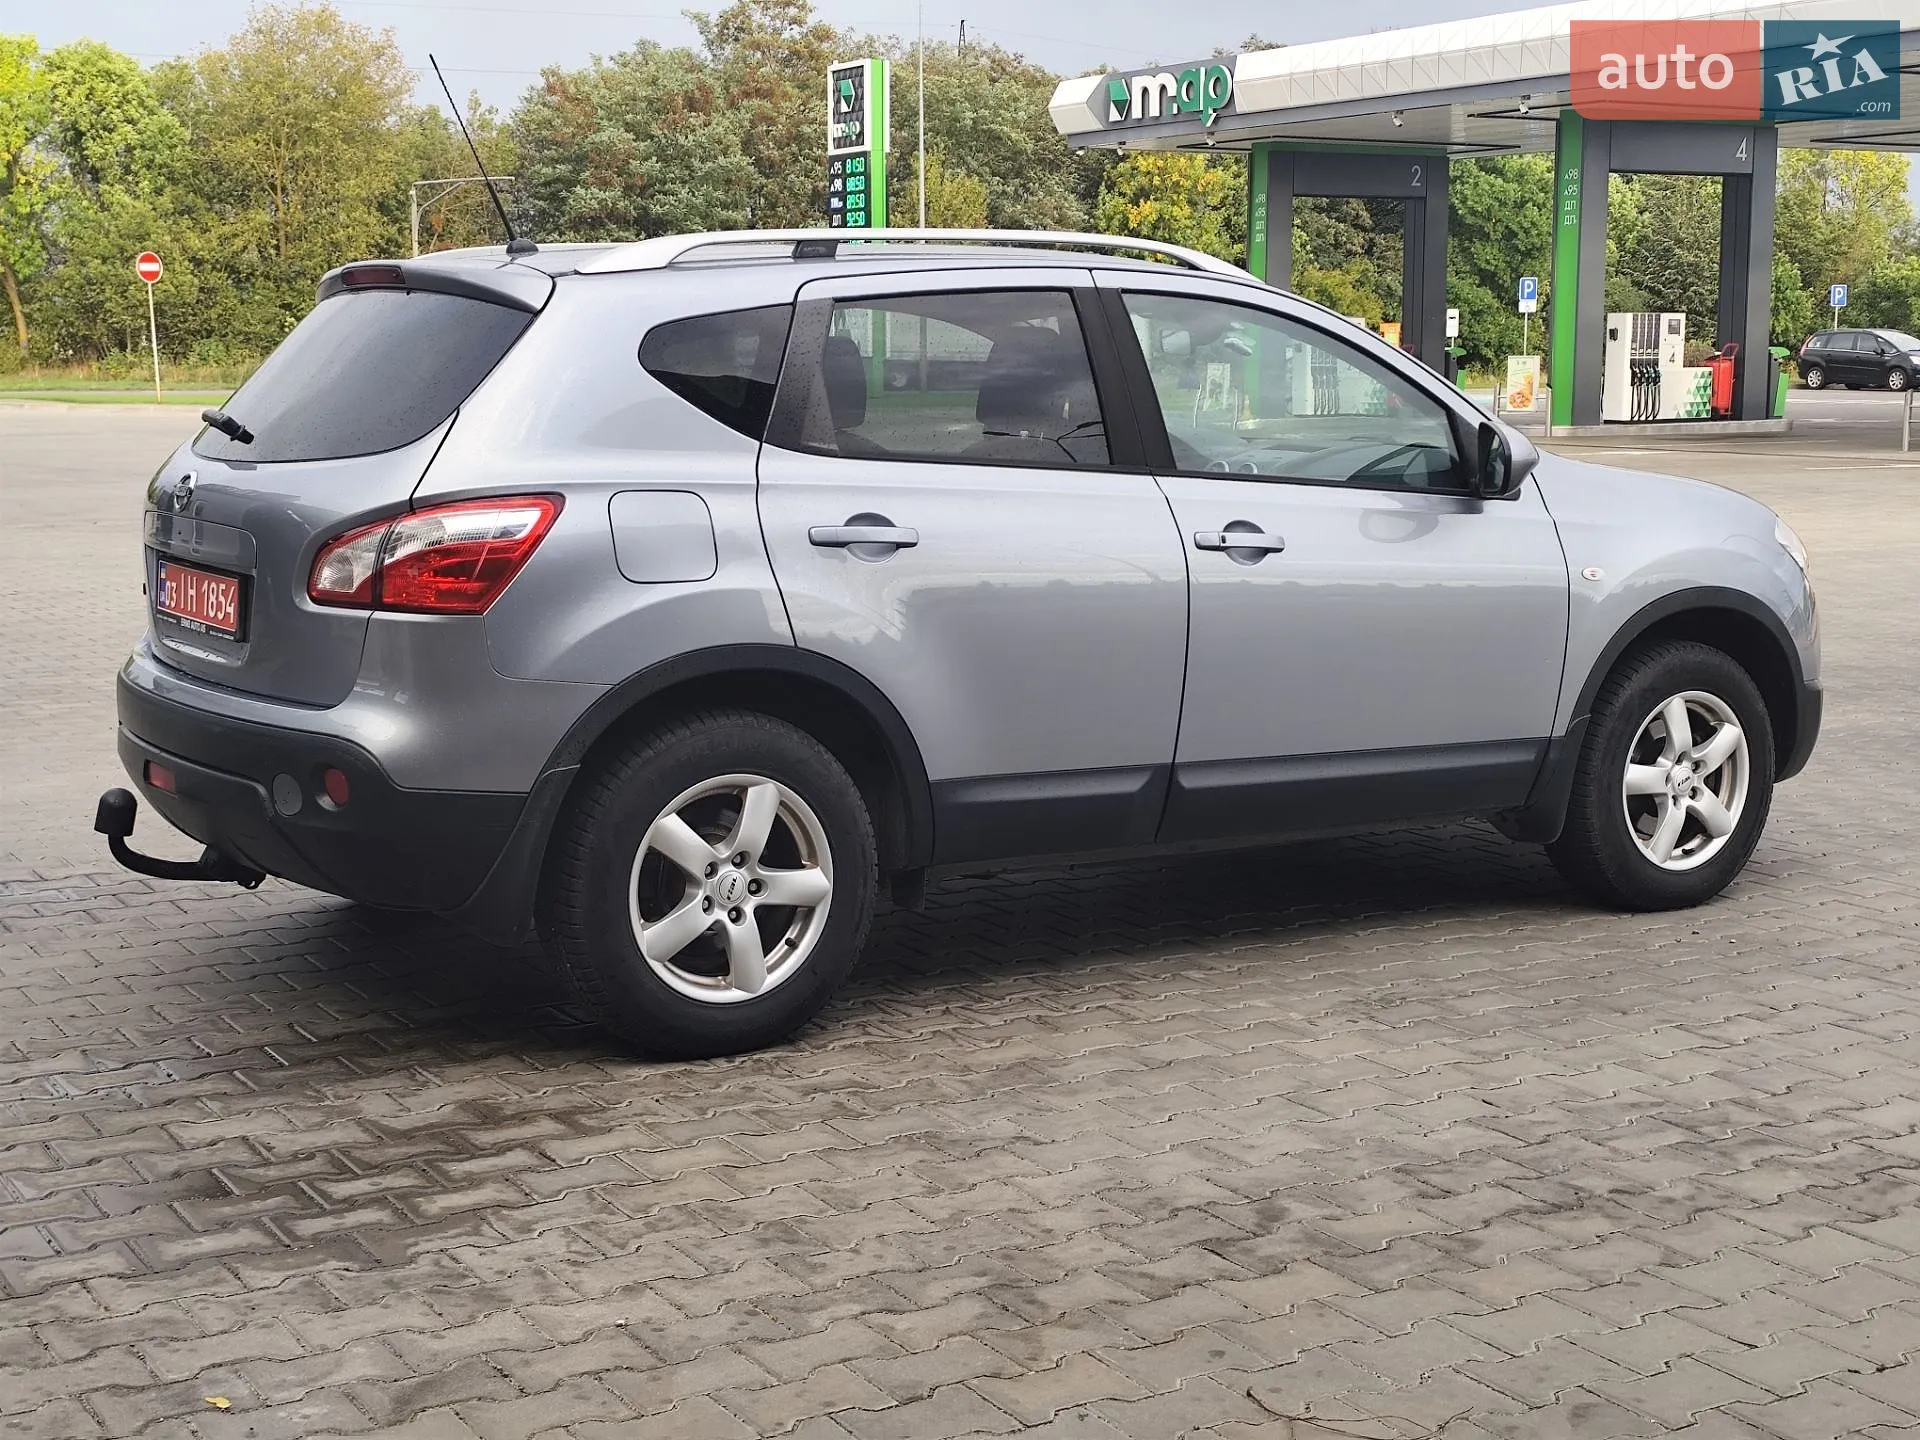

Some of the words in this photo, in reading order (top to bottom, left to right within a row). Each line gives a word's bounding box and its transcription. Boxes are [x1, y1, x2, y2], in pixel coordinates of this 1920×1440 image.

[1735, 136, 1748, 161] 4
[1411, 165, 1422, 187] 2
[1524, 280, 1534, 299] P
[1835, 287, 1844, 305] P
[165, 580, 177, 609] 03
[181, 573, 197, 613] IH
[202, 579, 236, 624] 1854
